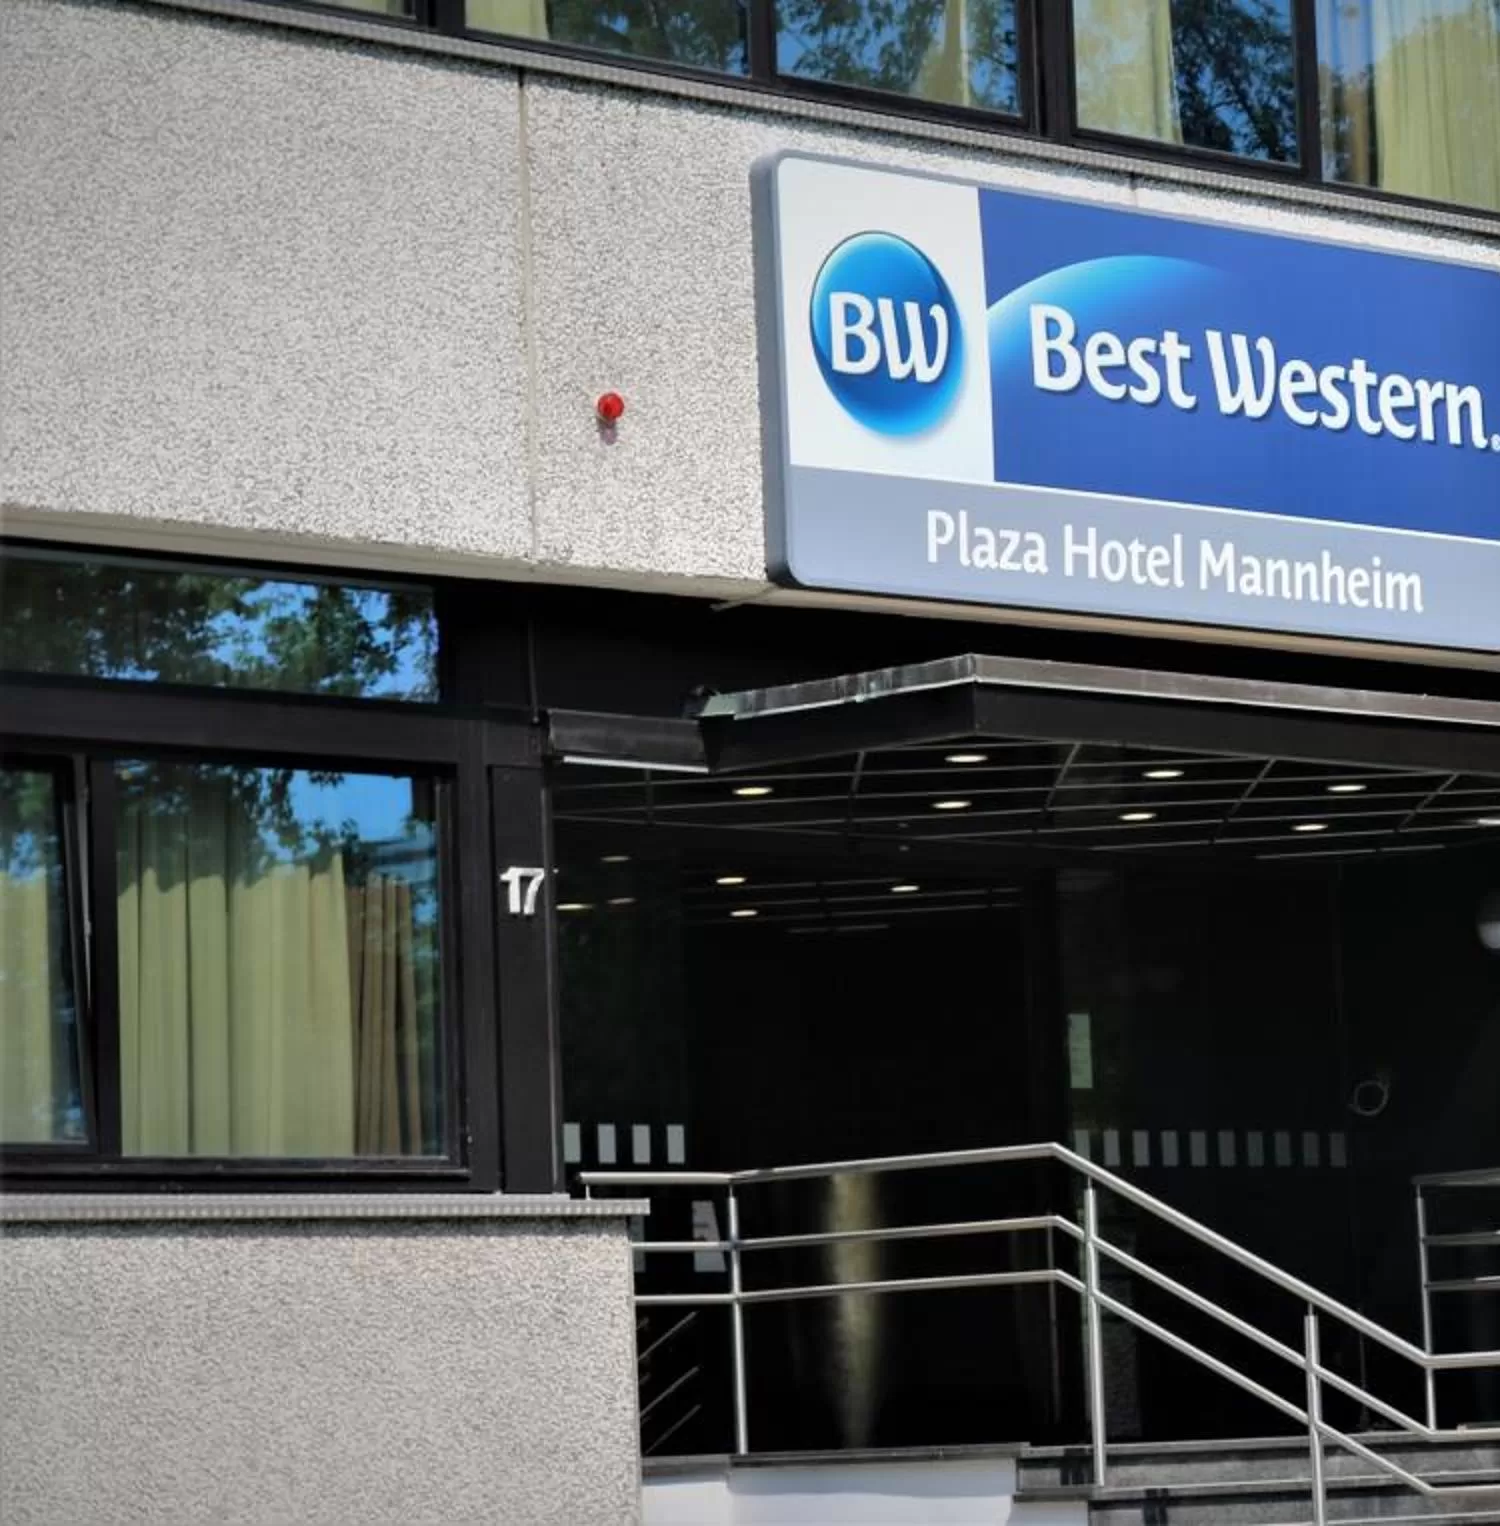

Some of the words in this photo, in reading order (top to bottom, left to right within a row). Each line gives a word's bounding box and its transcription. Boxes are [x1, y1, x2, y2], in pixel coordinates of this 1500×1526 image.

[829, 291, 949, 383] BW
[1029, 303, 1197, 409] Best
[927, 509, 1048, 575] Plaza
[1063, 523, 1184, 588] Hotel
[1200, 539, 1424, 614] Mannheim
[500, 866, 545, 915] 17
